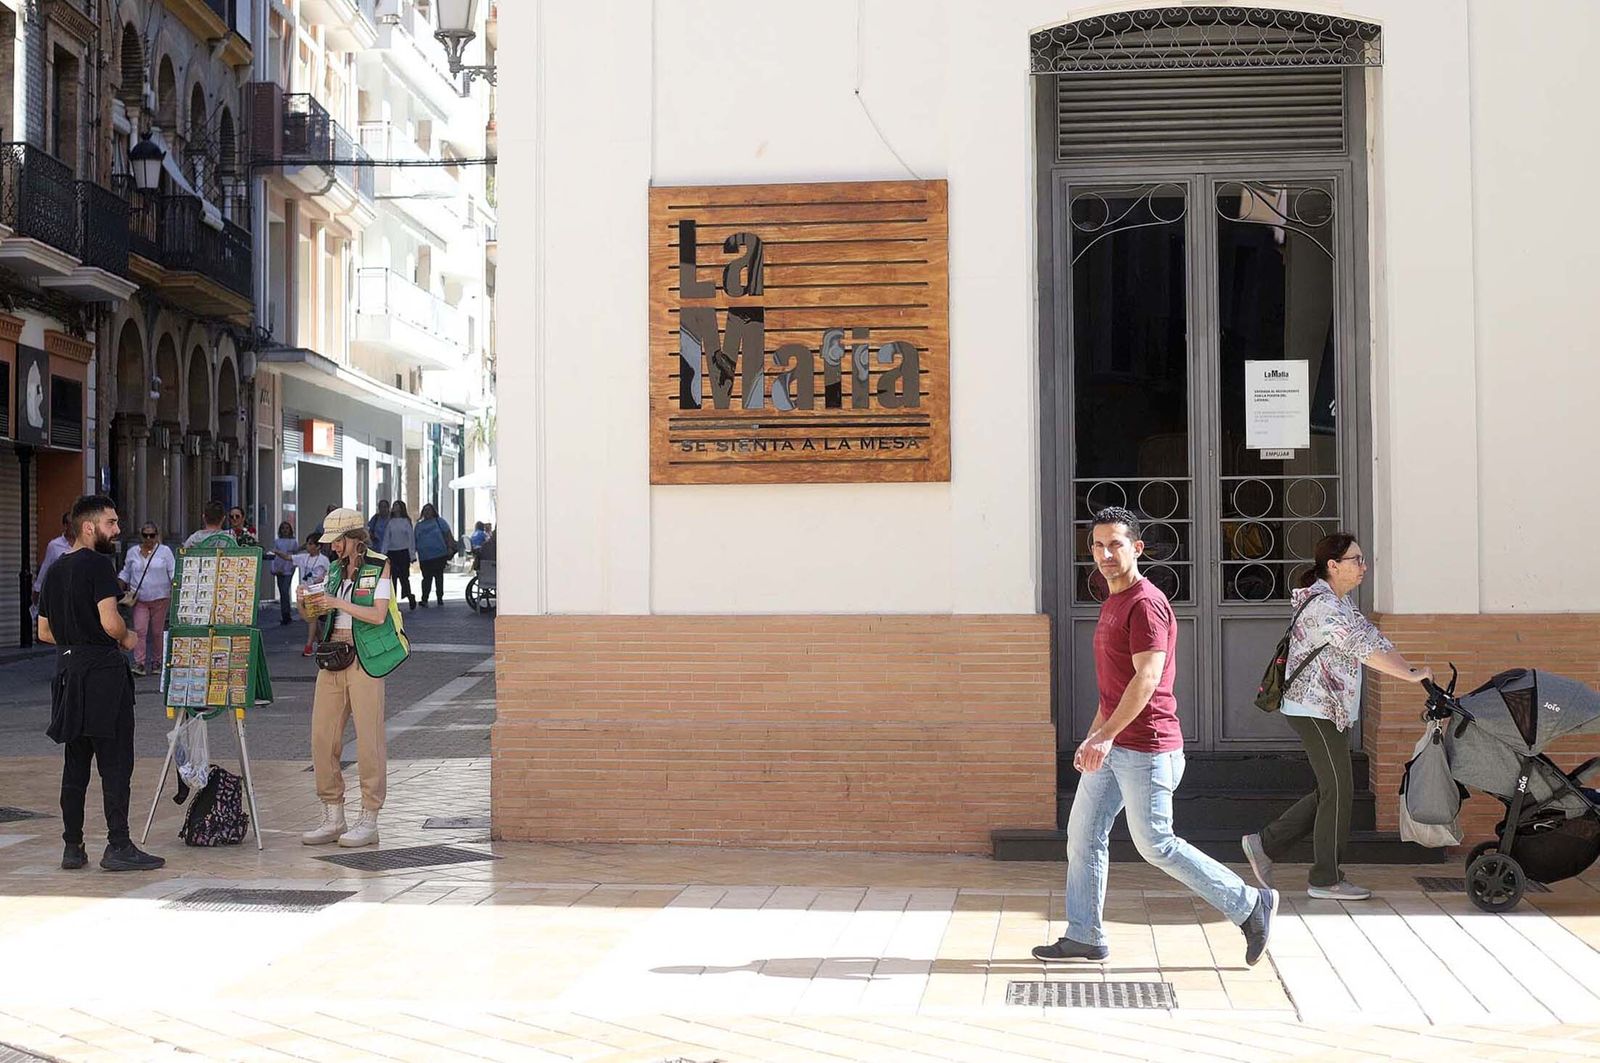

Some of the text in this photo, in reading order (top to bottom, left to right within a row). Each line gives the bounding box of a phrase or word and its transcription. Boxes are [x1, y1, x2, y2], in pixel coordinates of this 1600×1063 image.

[679, 219, 764, 299] La
[679, 306, 921, 412] Mafia
[681, 436, 921, 453] SE SIENTA A LA MESA
